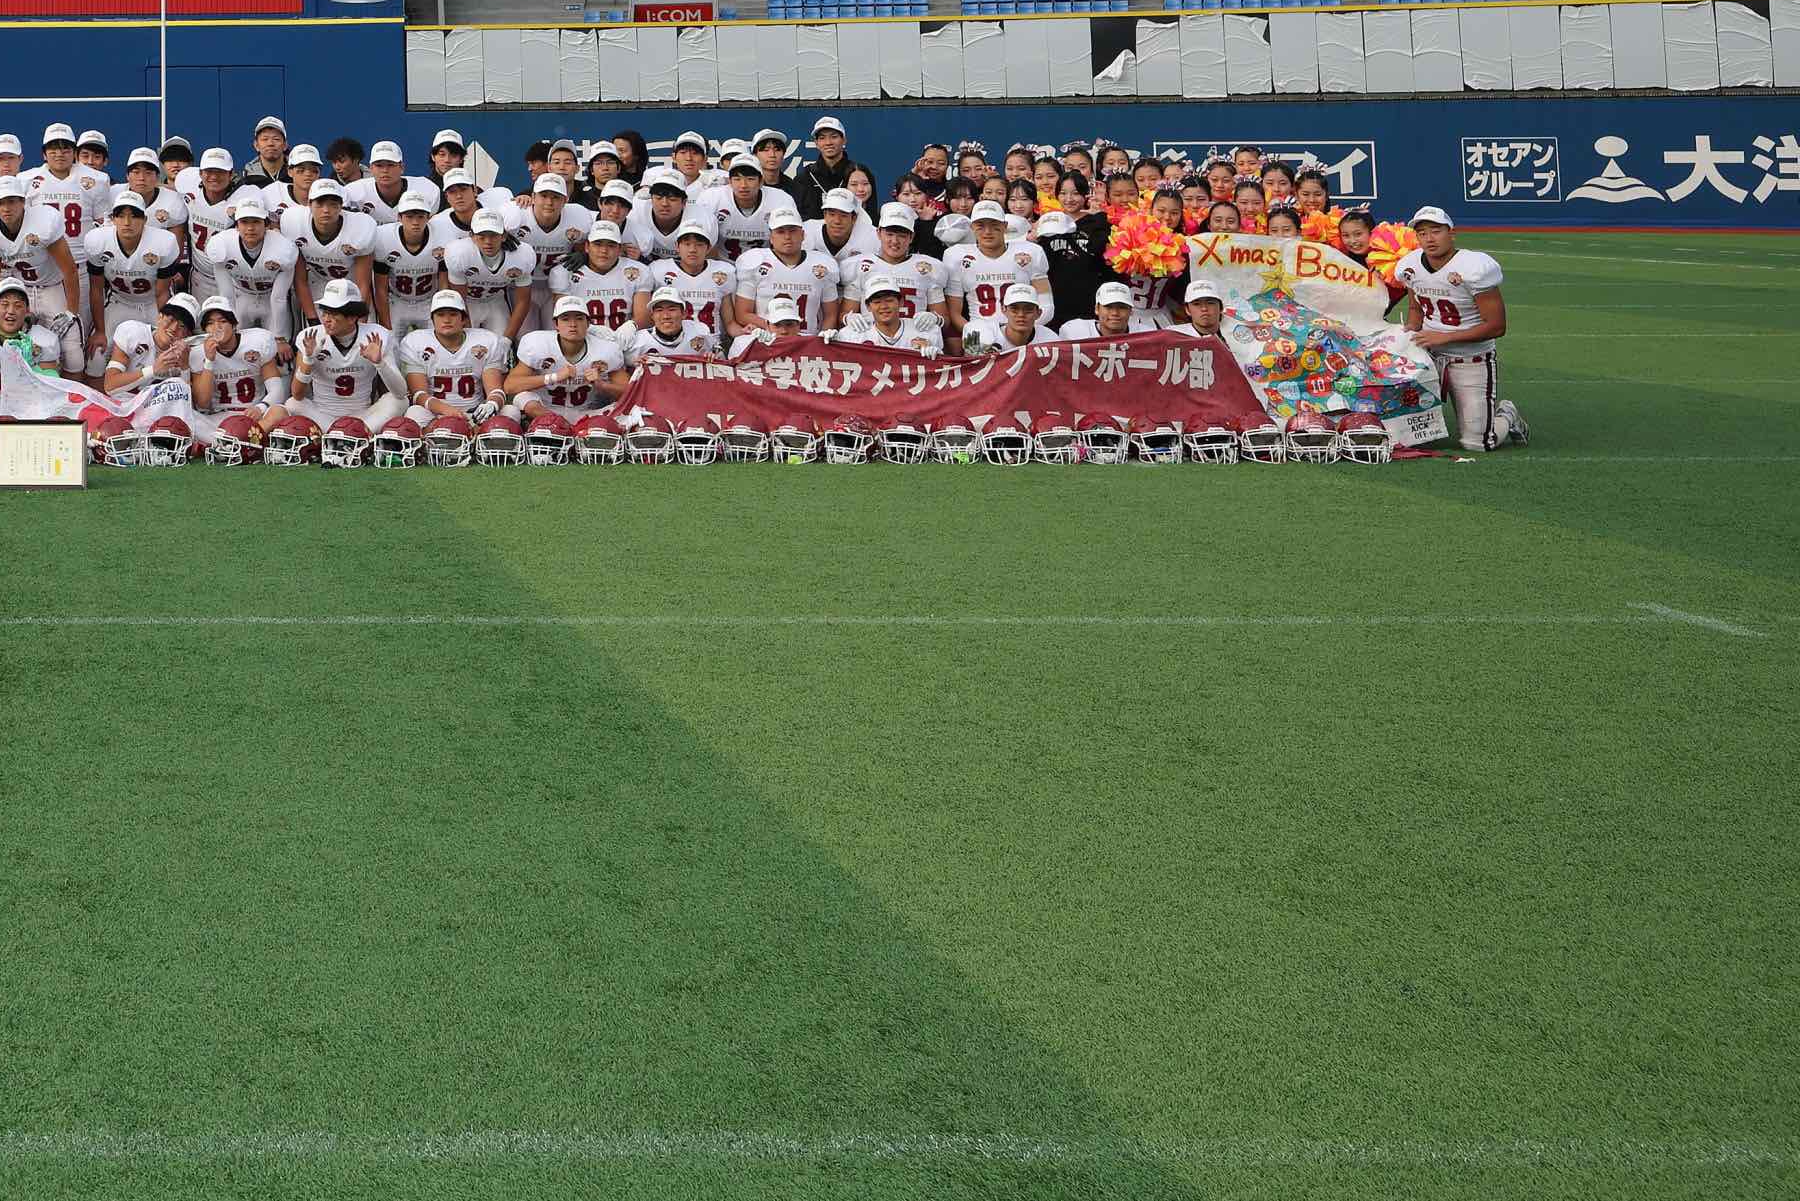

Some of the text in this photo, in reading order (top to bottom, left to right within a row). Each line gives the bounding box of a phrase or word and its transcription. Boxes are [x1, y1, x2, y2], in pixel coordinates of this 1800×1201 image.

[1465, 141, 1554, 169] オセアン
[1468, 170, 1558, 198] グループ
[395, 274, 433, 296] 82
[588, 298, 628, 332] 96
[216, 376, 257, 405] 10
[335, 375, 355, 396] 9
